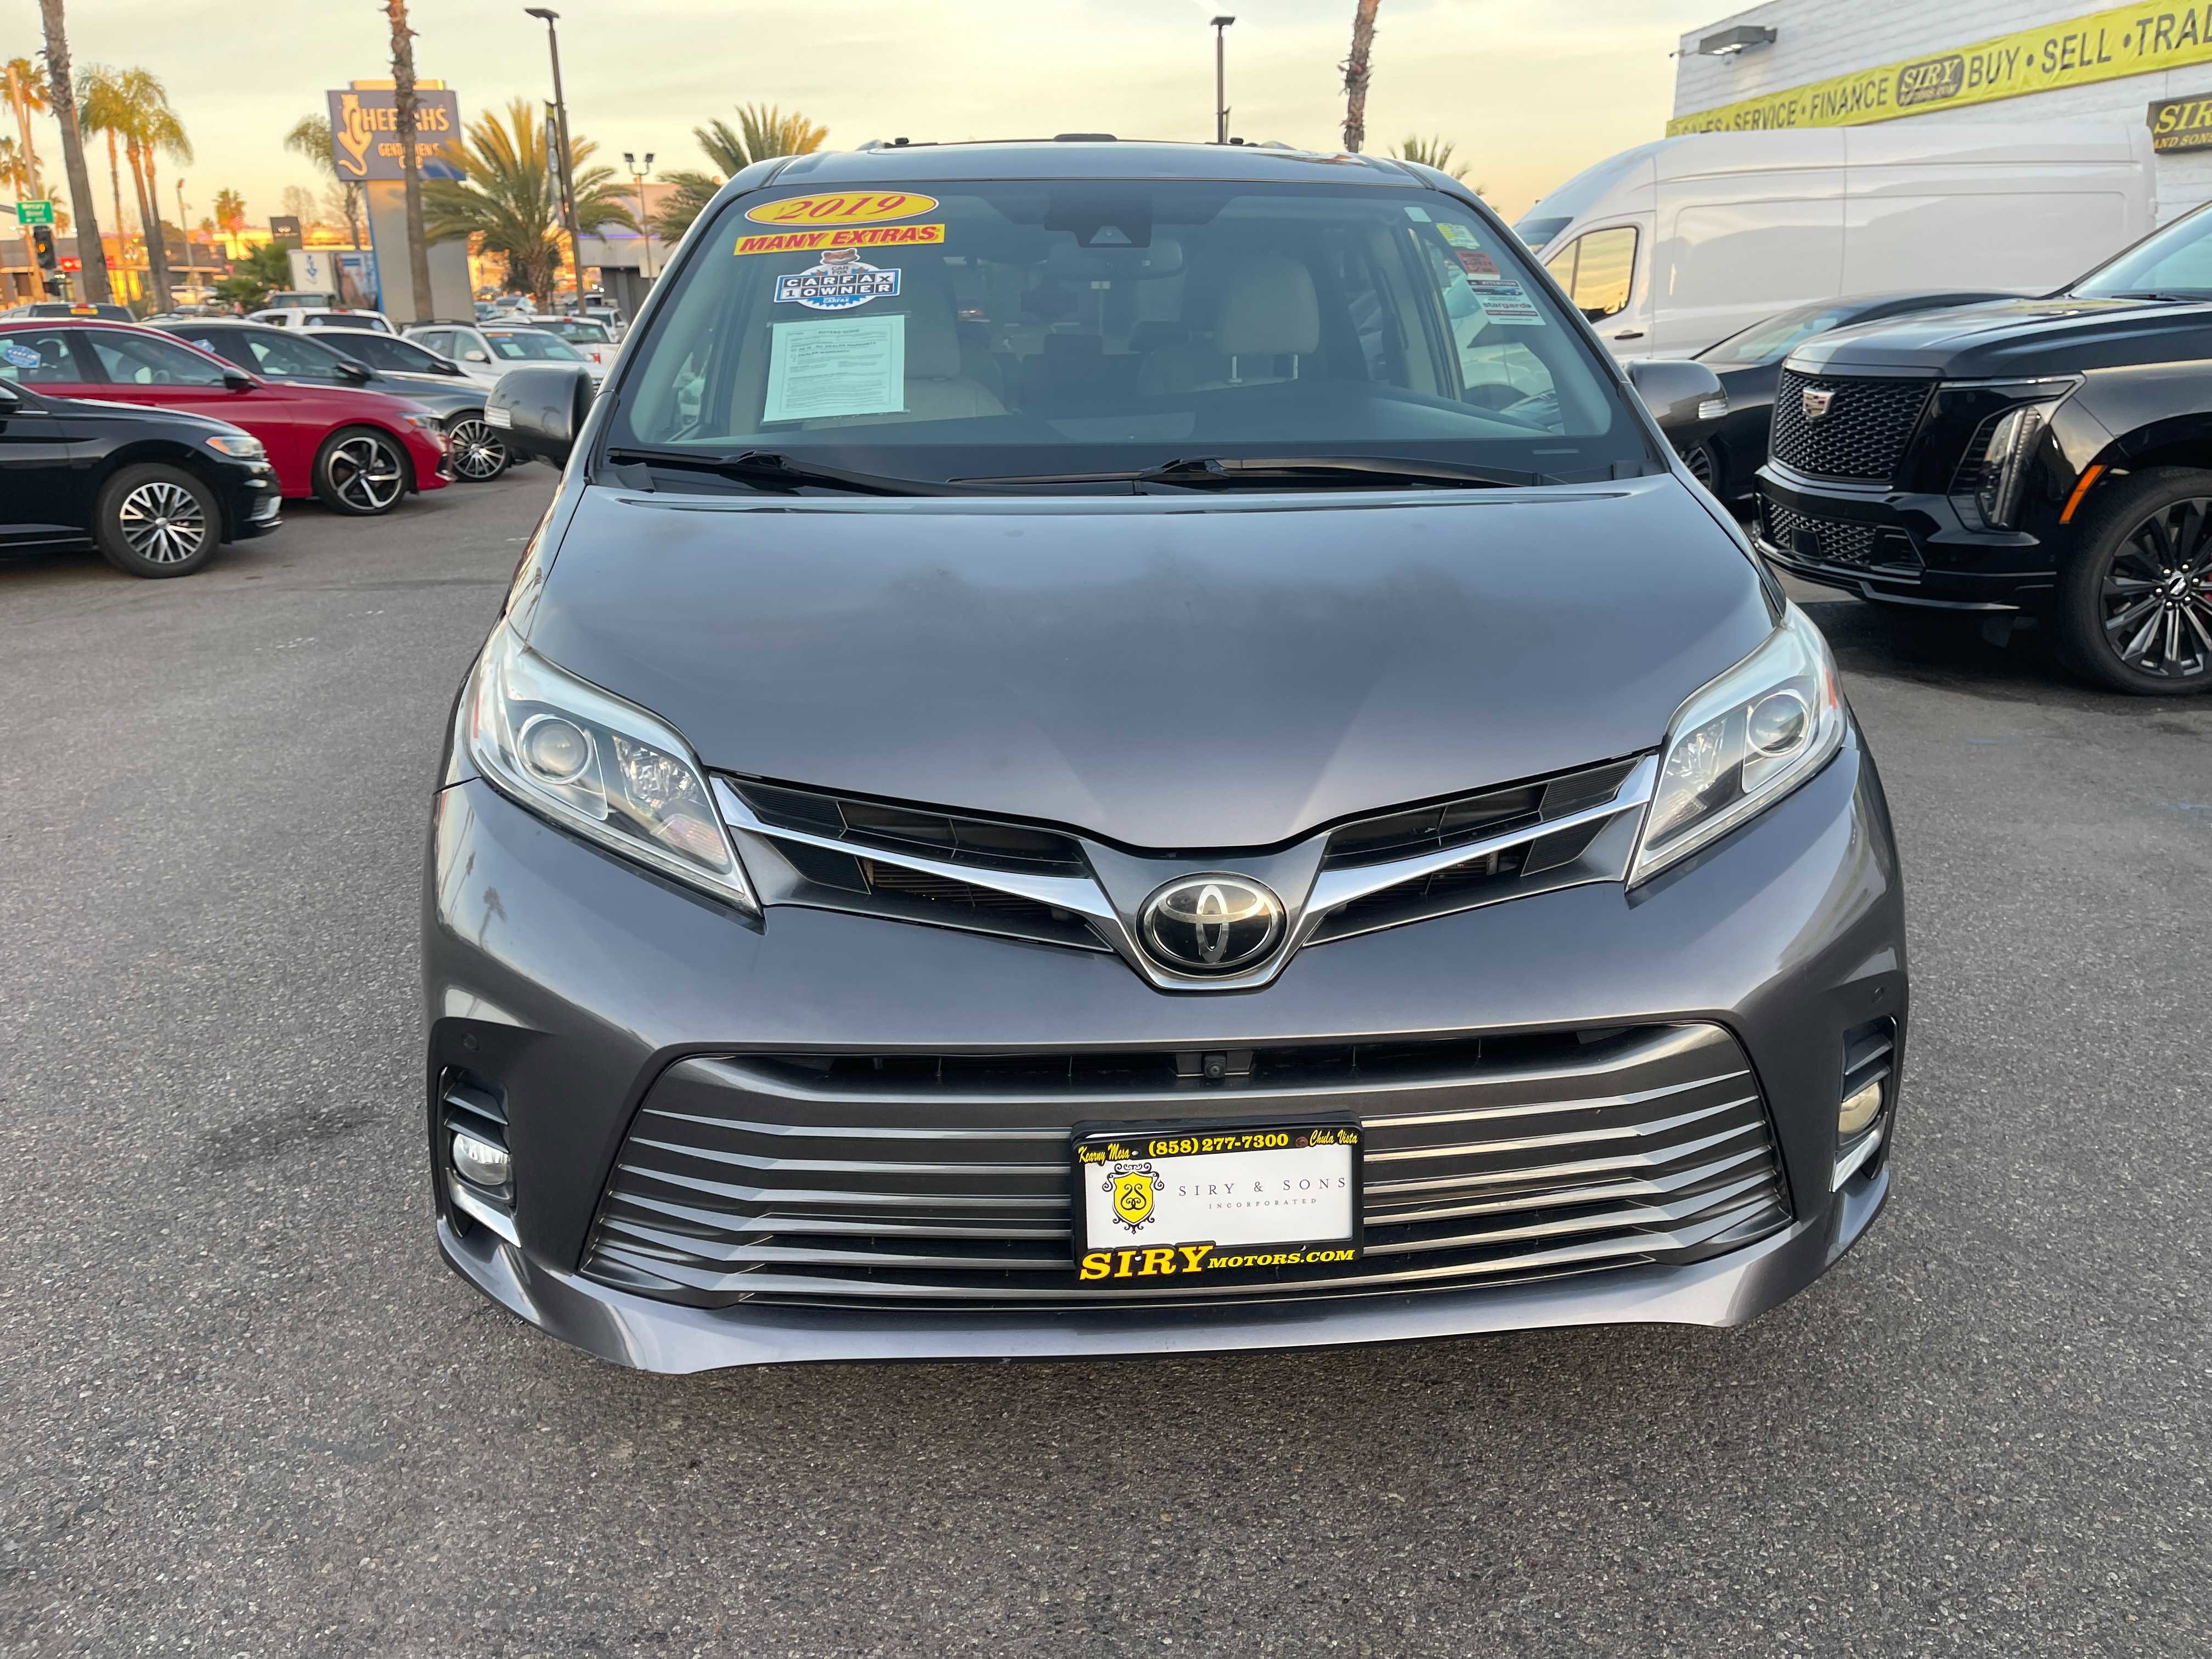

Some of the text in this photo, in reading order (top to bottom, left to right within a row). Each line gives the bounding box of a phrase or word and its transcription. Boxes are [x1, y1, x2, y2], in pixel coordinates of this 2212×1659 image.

[1968, 47, 2021, 88] BUY
[2041, 29, 2111, 74] SELL
[1900, 59, 1961, 92] SIRY
[1734, 100, 1797, 131] SERVICE
[1810, 77, 1889, 121] FINANCE
[772, 196, 906, 220] 2019
[740, 226, 939, 252] MANY EXTRAS
[786, 274, 892, 287] CARFAX
[803, 284, 890, 297] OWNER
[1078, 1128, 1358, 1164] Kearny Mesa (858) 277-7300 Chula Vista
[1179, 1177, 1345, 1197] SIRY & SONS
[1209, 1198, 1317, 1210] INCORPORATED
[1079, 1245, 1356, 1280] SIRY MOTORS.COM
